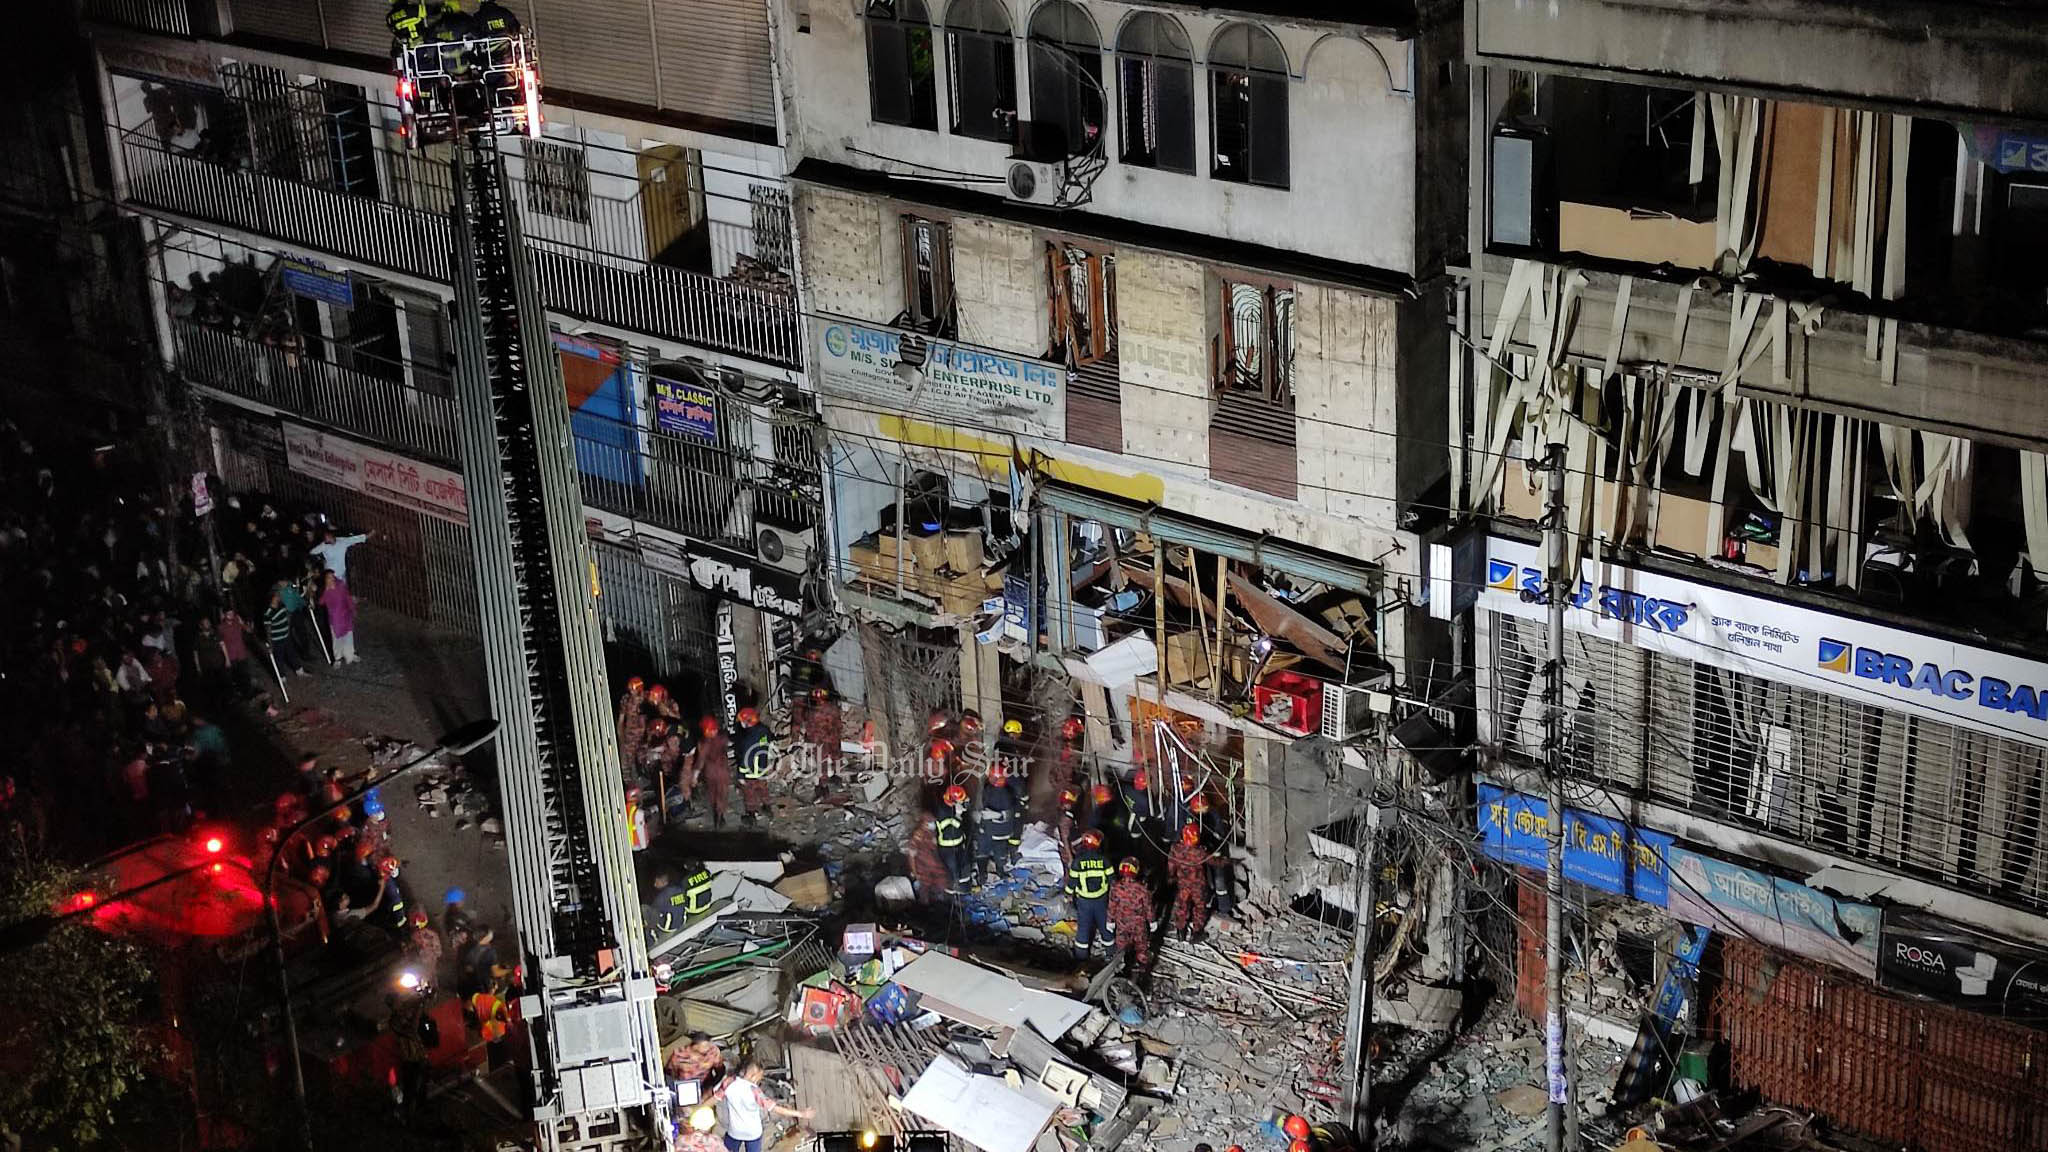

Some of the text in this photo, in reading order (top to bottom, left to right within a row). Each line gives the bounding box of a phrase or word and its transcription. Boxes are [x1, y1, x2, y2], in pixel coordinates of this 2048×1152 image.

[850, 350, 876, 365] M/S.
[933, 369, 1022, 397] ENTERPRISE
[1025, 388, 1054, 406] LTD.
[676, 387, 713, 408] CLASSIC
[1761, 624, 1800, 644] লিমিটেড
[1762, 640, 1782, 653] শাখা
[1855, 646, 1974, 701] BRAC
[1080, 860, 1104, 870] FIRE
[687, 871, 709, 887] FIRE
[1896, 942, 1946, 970] ROSA
